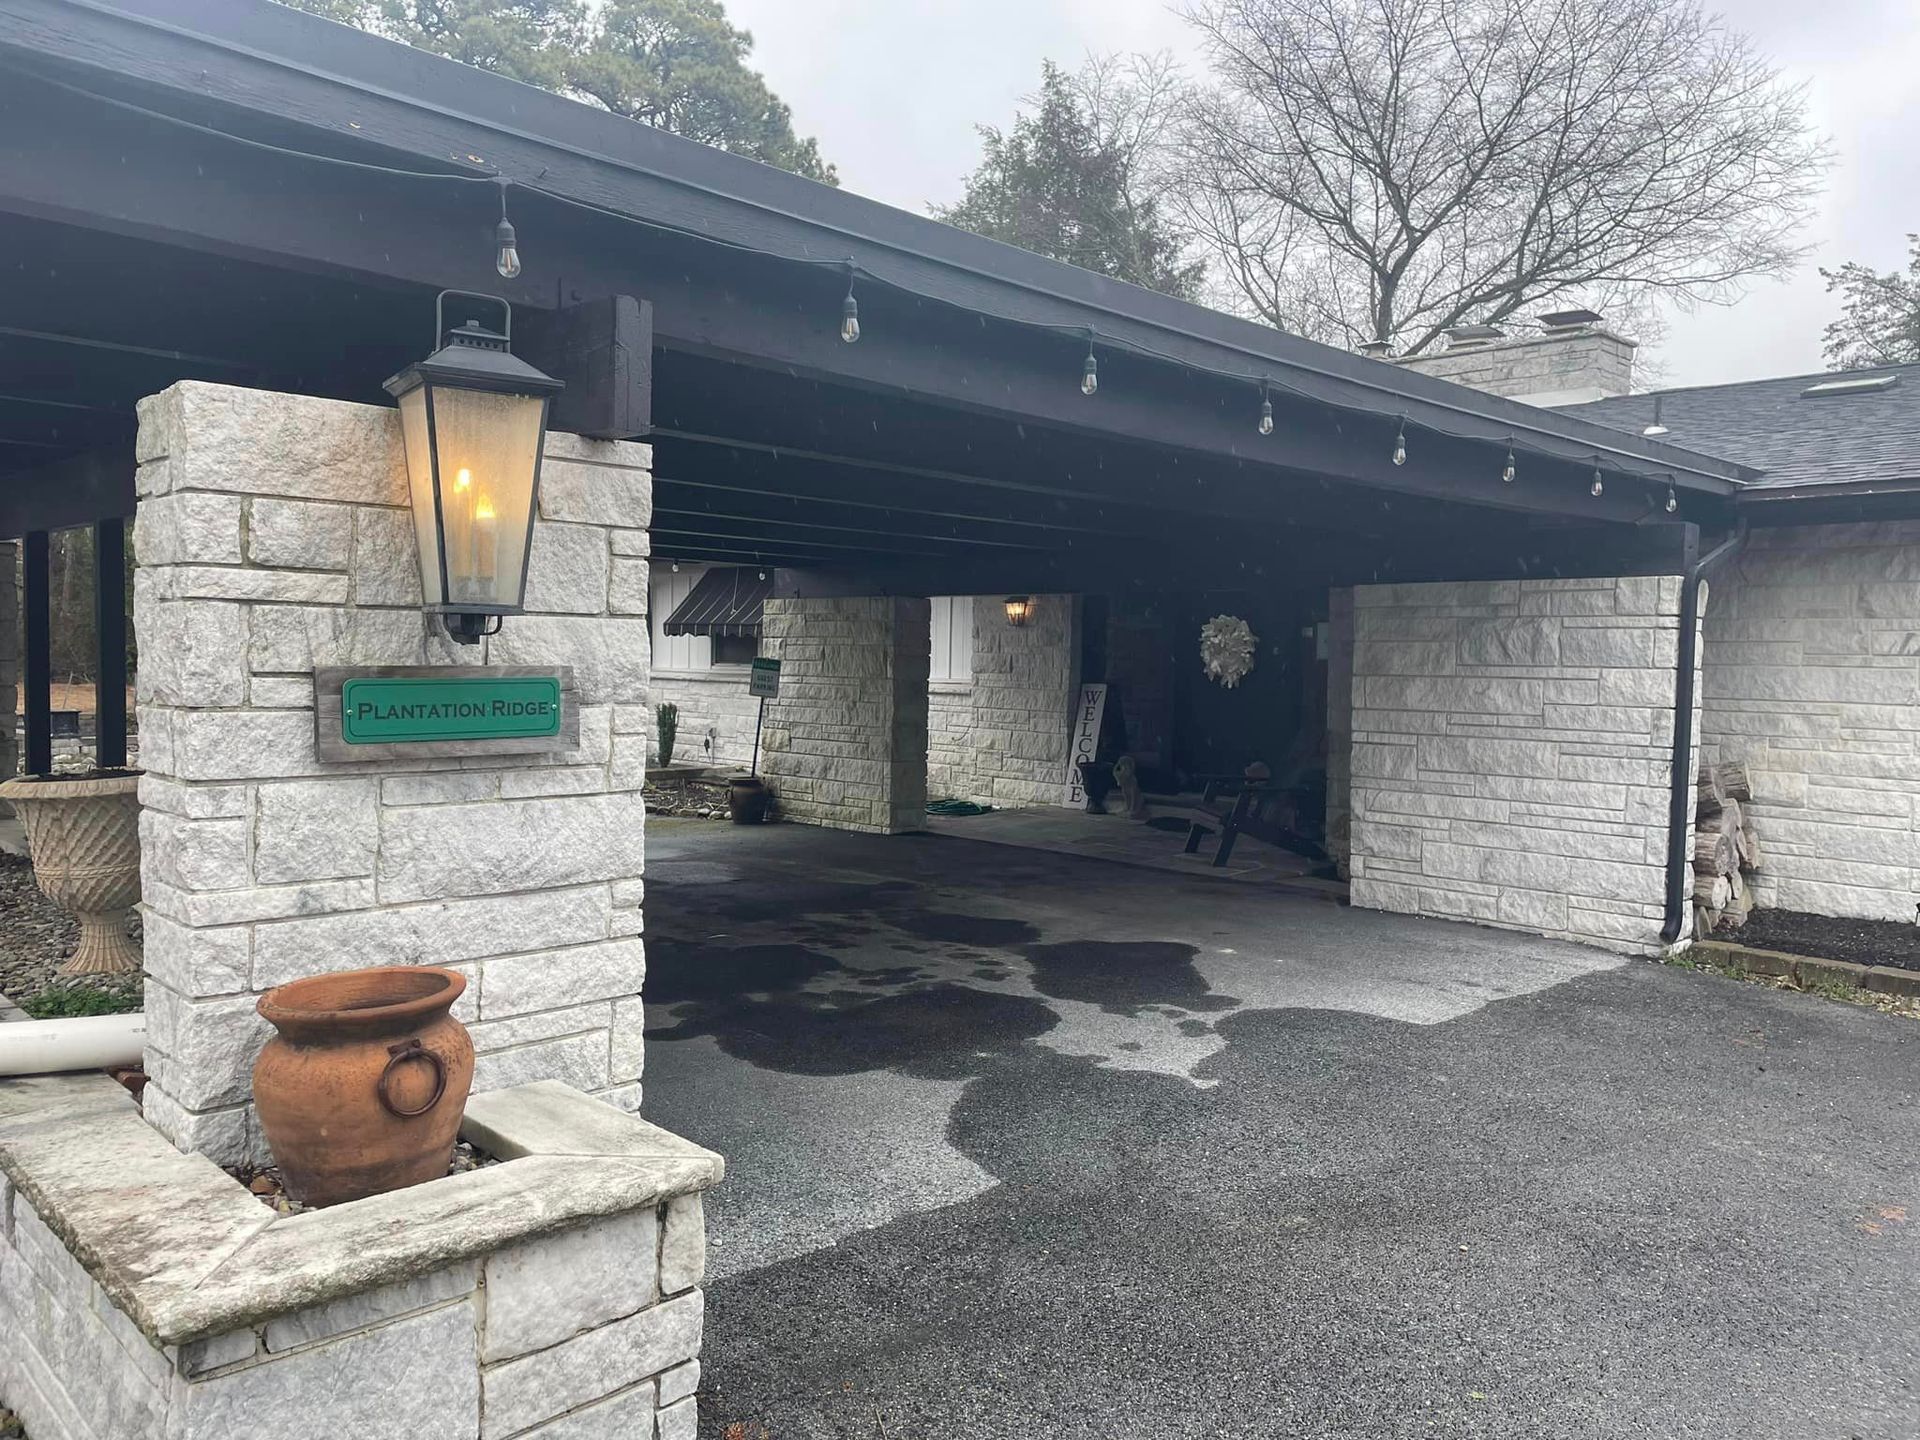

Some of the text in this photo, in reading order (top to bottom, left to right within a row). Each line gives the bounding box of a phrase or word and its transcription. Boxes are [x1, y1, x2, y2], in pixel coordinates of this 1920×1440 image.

[358, 700, 549, 720] PLANTATION RIDGE
[1070, 691, 1102, 802] WELCOME
